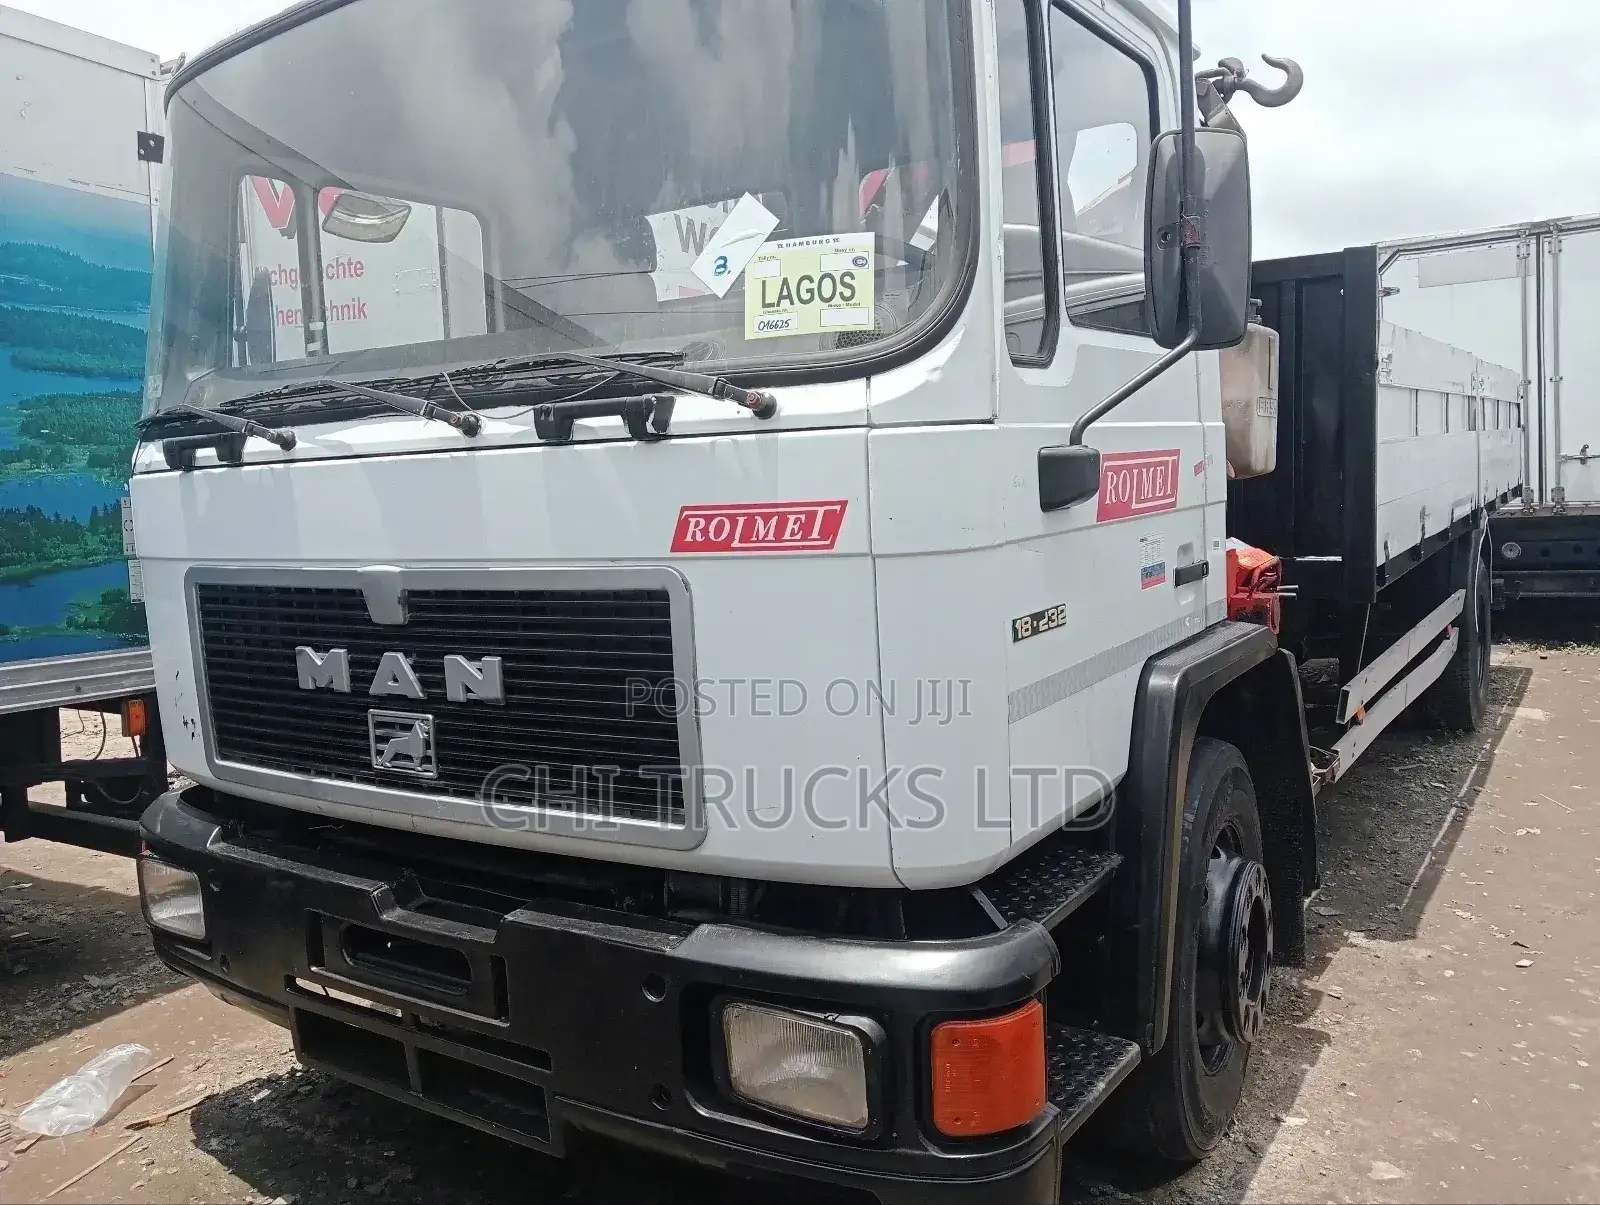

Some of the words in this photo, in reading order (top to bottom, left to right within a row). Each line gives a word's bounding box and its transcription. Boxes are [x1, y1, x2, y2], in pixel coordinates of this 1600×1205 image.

[785, 237, 831, 249] HAMBURG
[761, 271, 856, 309] LAGOS
[757, 318, 792, 332] 016625
[1103, 455, 1178, 509] ROLMET
[683, 505, 842, 547] ROLMET
[295, 645, 506, 705] MAN
